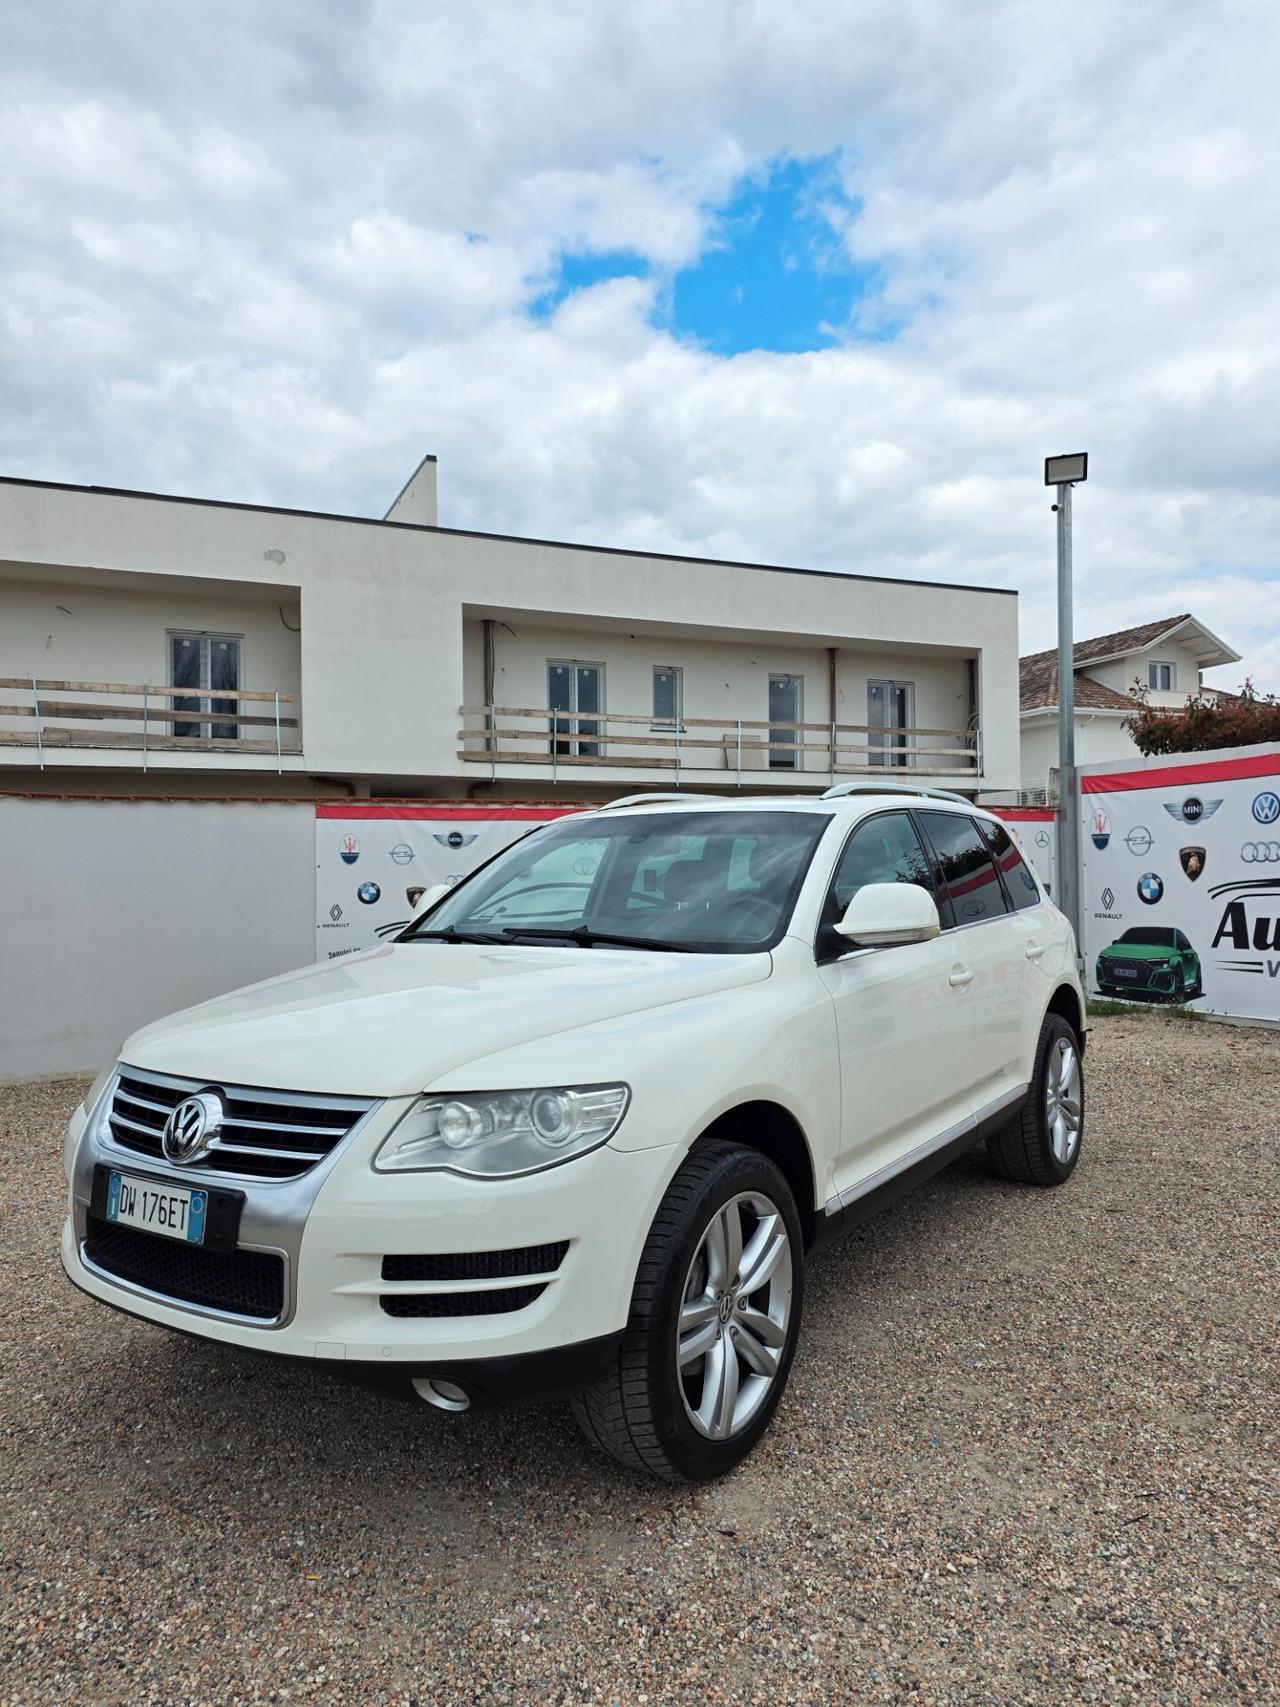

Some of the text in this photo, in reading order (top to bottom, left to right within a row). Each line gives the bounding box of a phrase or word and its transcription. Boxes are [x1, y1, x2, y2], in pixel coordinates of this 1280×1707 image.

[1183, 805, 1203, 815] MINI
[1094, 912, 1123, 920] RENAULT
[1211, 902, 1280, 951] Au
[120, 1184, 137, 1217] DW
[143, 1191, 188, 1230] 176ET
